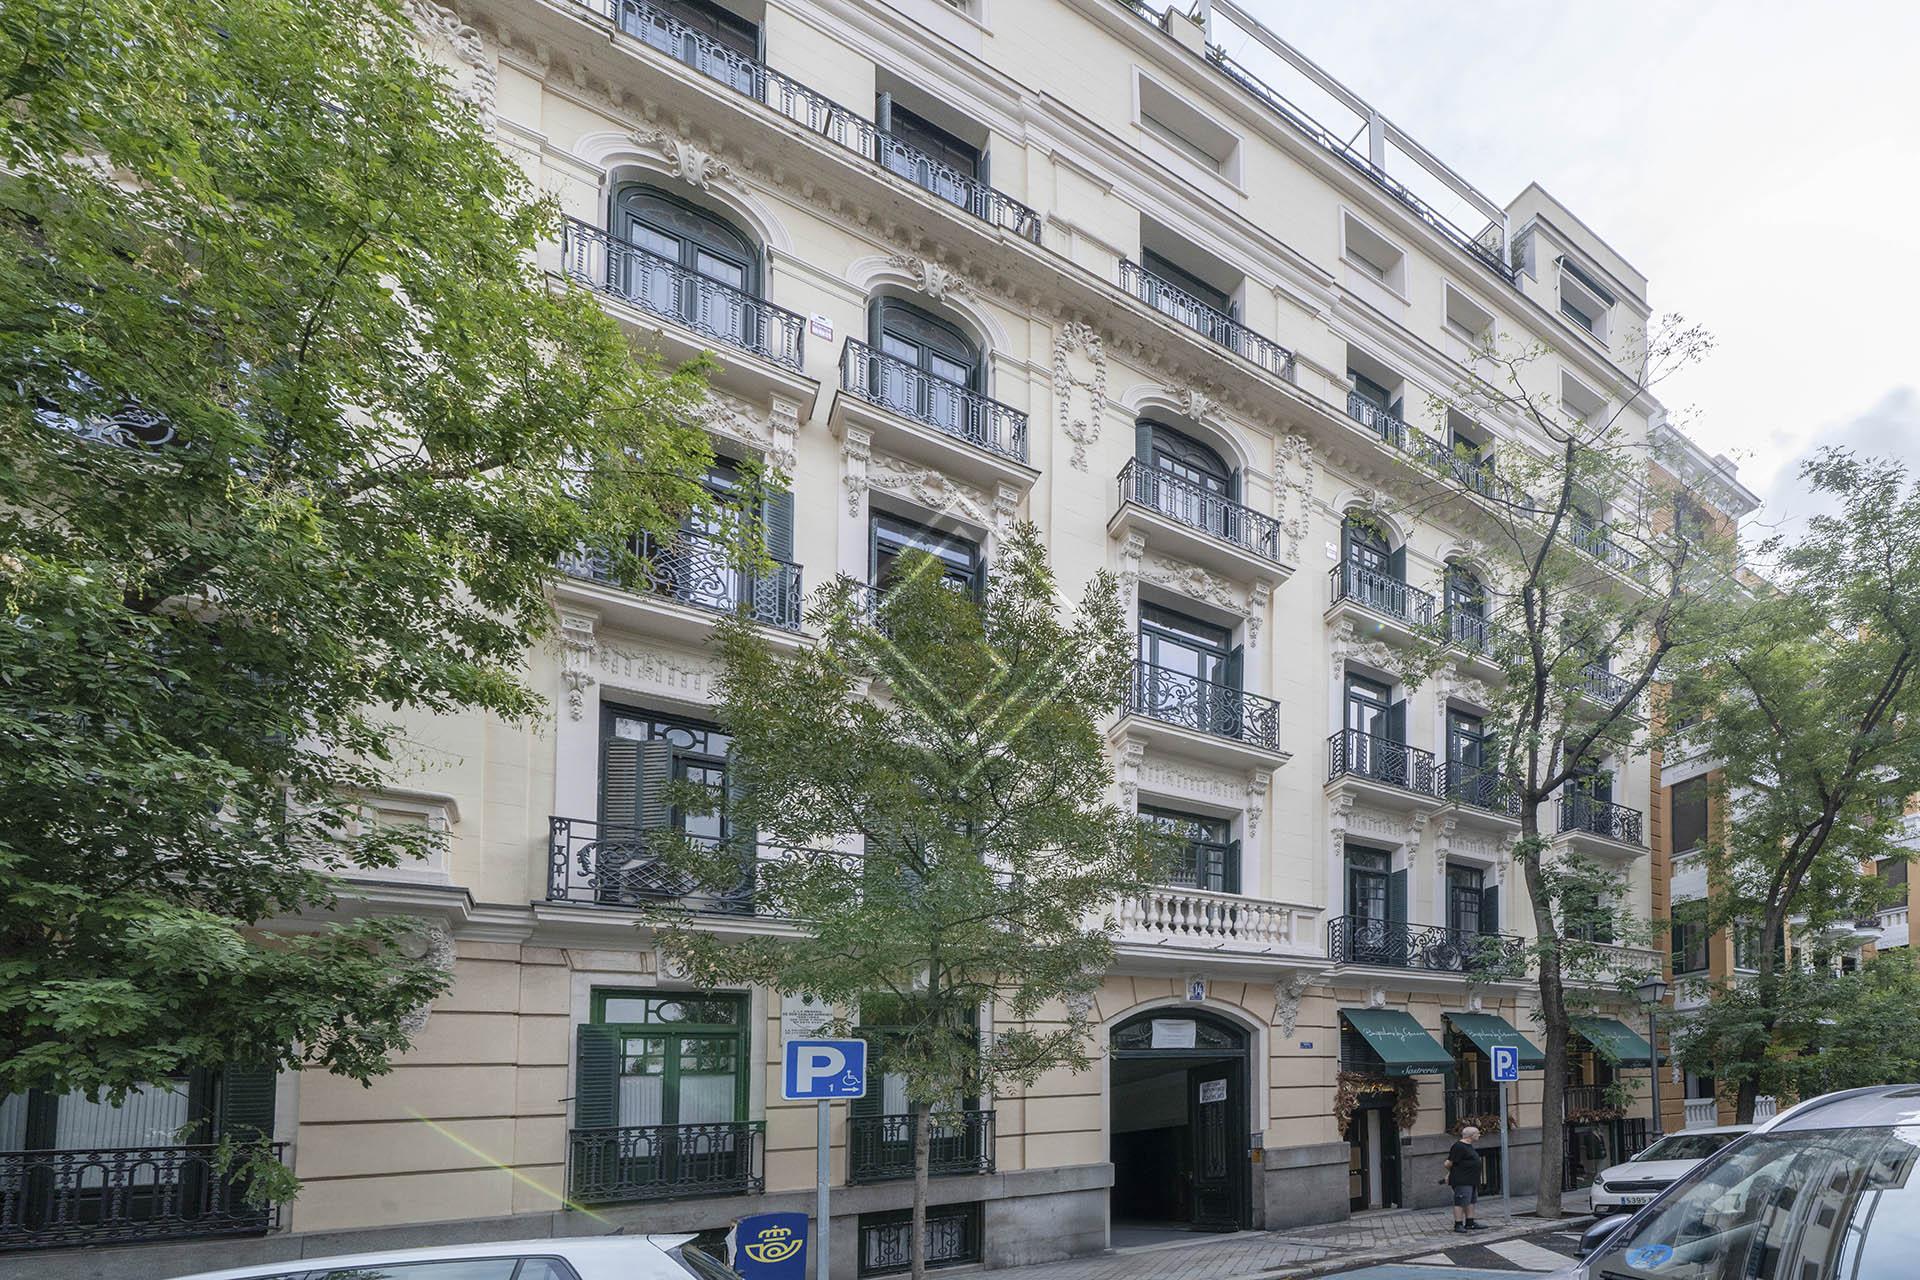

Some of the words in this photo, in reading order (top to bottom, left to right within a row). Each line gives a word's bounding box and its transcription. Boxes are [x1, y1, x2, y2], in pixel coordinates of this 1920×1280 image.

[1194, 983, 1203, 996] 14
[796, 1046, 847, 1093] P
[1497, 1050, 1512, 1077] P
[829, 1083, 834, 1093] 1
